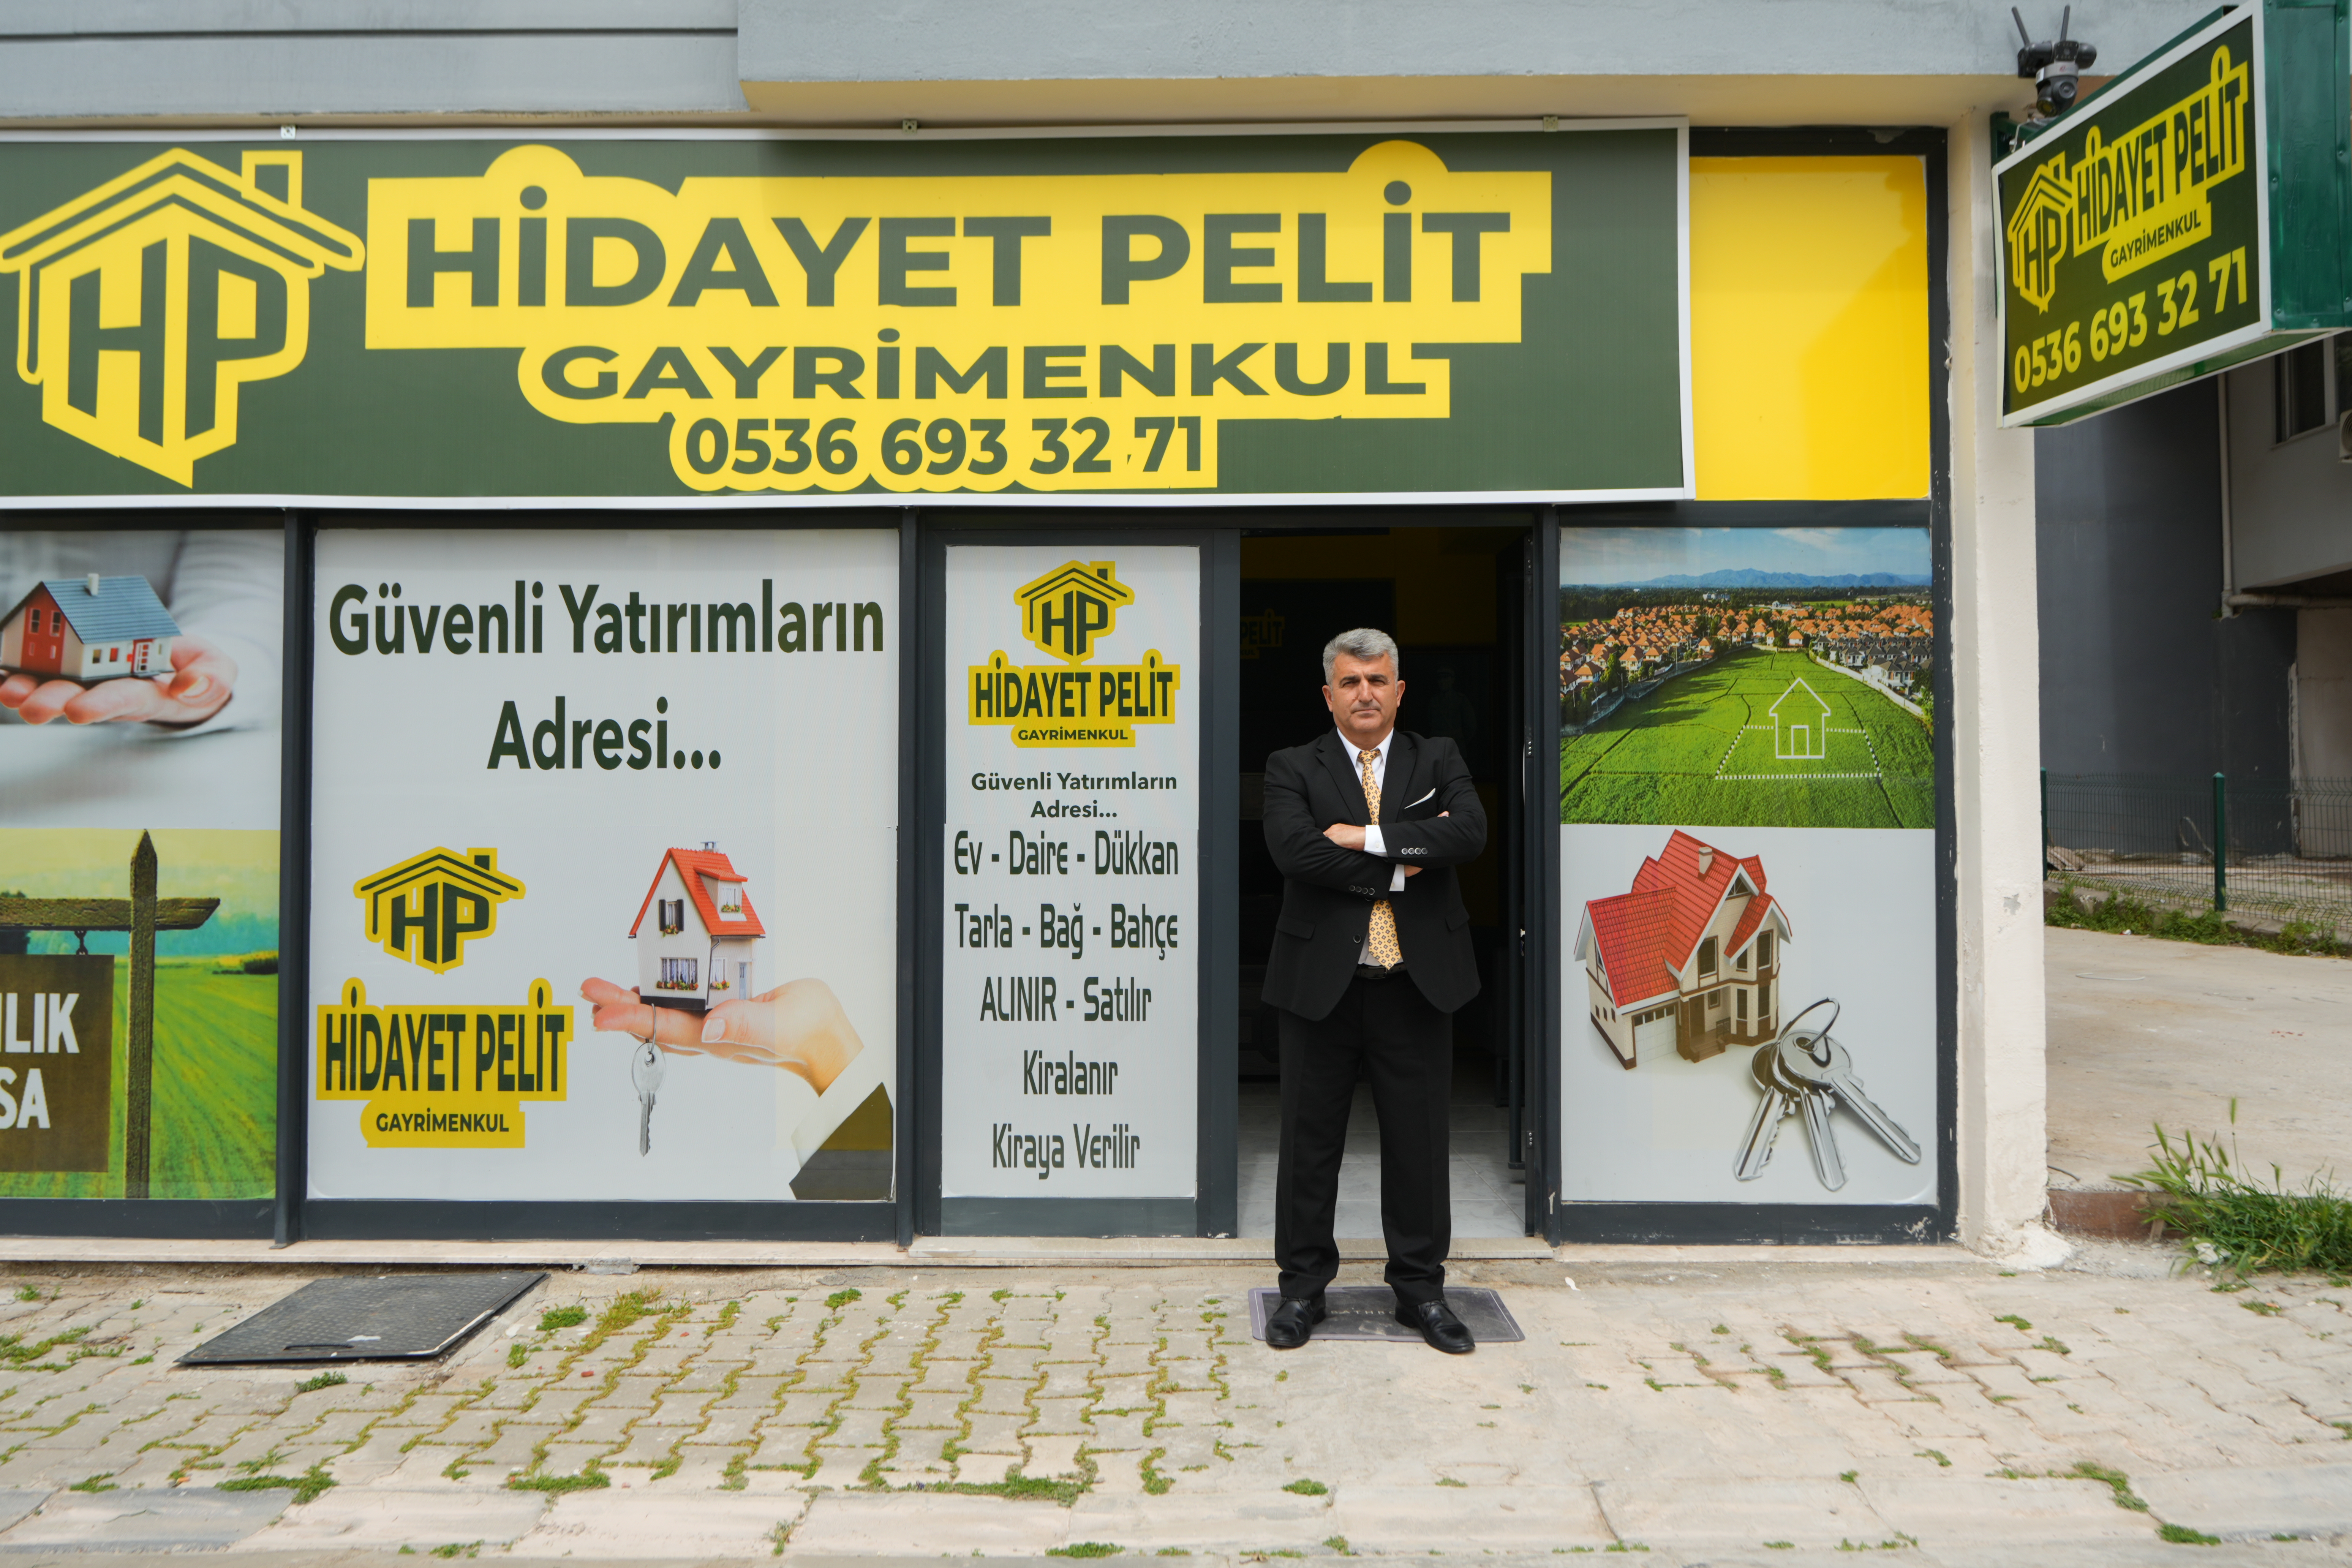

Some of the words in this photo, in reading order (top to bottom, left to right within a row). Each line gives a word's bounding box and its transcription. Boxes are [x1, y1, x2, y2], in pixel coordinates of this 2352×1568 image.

[2077, 120, 2167, 246] HİDAYET
[2173, 55, 2241, 195] PELİT
[406, 185, 1051, 308] HİDAYET
[1101, 180, 1511, 305] PELİT
[2110, 209, 2202, 268] GAYRİMENKUL
[67, 233, 288, 448] HP
[2014, 321, 2081, 394] 0536
[2090, 292, 2147, 362] 693
[2157, 270, 2199, 335] 32
[2209, 246, 2247, 315] 71
[541, 327, 1426, 400] GAYRİMENKUL
[686, 417, 858, 475] 0536
[880, 417, 1008, 475] 693
[1029, 416, 1111, 473] 32
[1135, 416, 1202, 472] 71
[330, 580, 543, 655] Güvenli
[558, 579, 884, 653] Yatırımların
[1042, 590, 1108, 656] HP
[976, 657, 1091, 718] HİDAYET
[1100, 656, 1173, 717] PELİT
[487, 696, 721, 770] Adresi...
[1018, 726, 1128, 740] GAYRİMENKUL
[971, 772, 1051, 790] Güvenli
[1057, 772, 1177, 789] Yatırımların
[1031, 800, 1117, 818] Adresi...
[955, 831, 983, 875] Ev
[1010, 831, 1068, 875] Daire
[1095, 830, 1178, 875] Dükkan
[391, 882, 489, 965] HP
[955, 903, 1012, 948] Tarla
[1041, 903, 1083, 959] Bağ
[1111, 903, 1178, 961] Bahçe
[0, 993, 80, 1053] LIK
[980, 977, 1057, 1021] ALINIR
[1084, 977, 1152, 1021] Satılır
[326, 986, 466, 1091] HİDAYET
[476, 986, 564, 1092] PELİT
[1024, 1050, 1118, 1095] Kiralanır
[376, 1107, 509, 1133] GAYRİMENKUL
[993, 1123, 1064, 1180] Kiraya
[1073, 1123, 1140, 1168] Verilir
